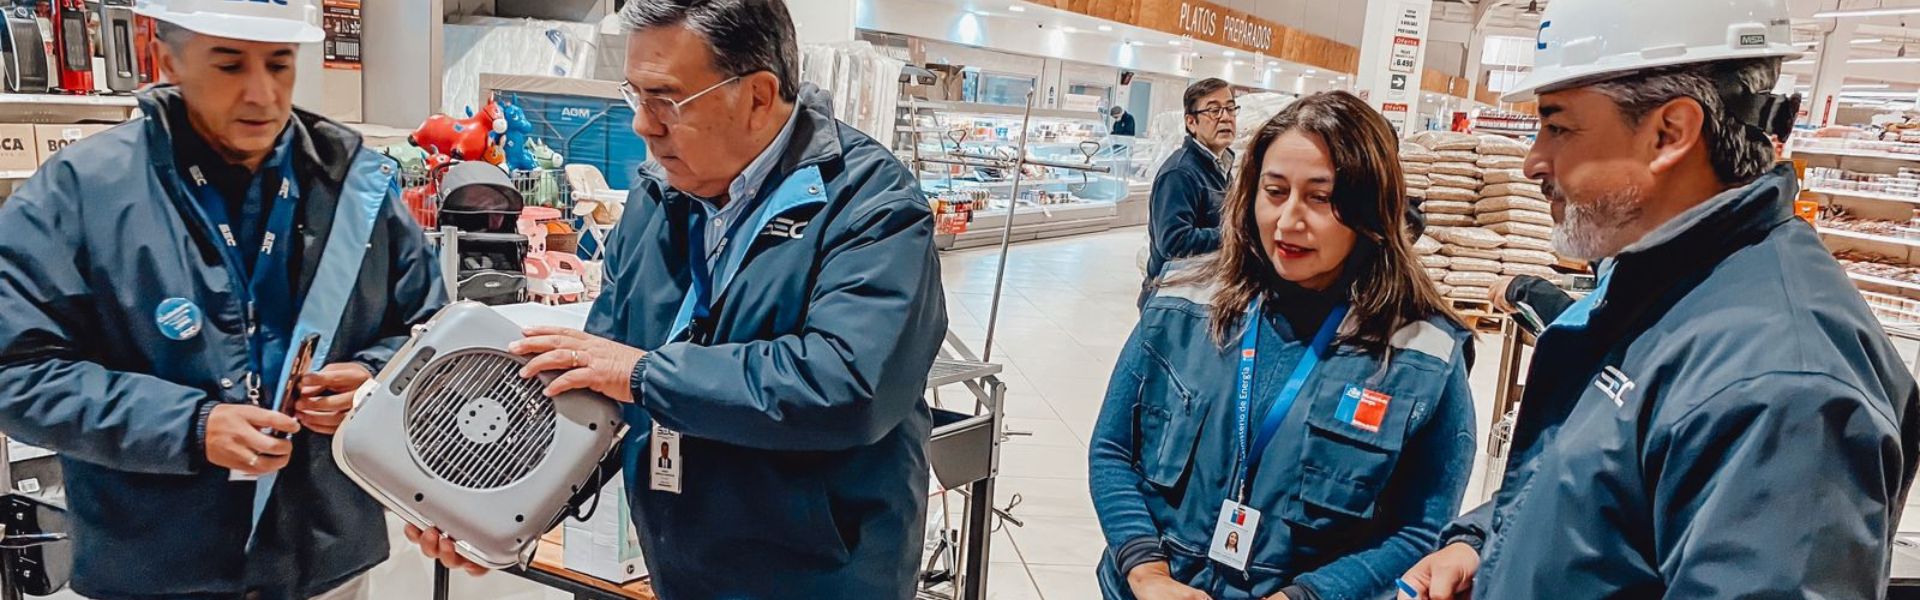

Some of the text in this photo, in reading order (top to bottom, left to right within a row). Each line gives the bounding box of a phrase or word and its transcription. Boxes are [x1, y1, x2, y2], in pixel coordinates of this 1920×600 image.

[1179, 3, 1272, 50] PLATOS PREPARADOS
[1239, 366, 1251, 399] Energía
[1594, 364, 1636, 408] SEC
[1239, 401, 1247, 412] de
